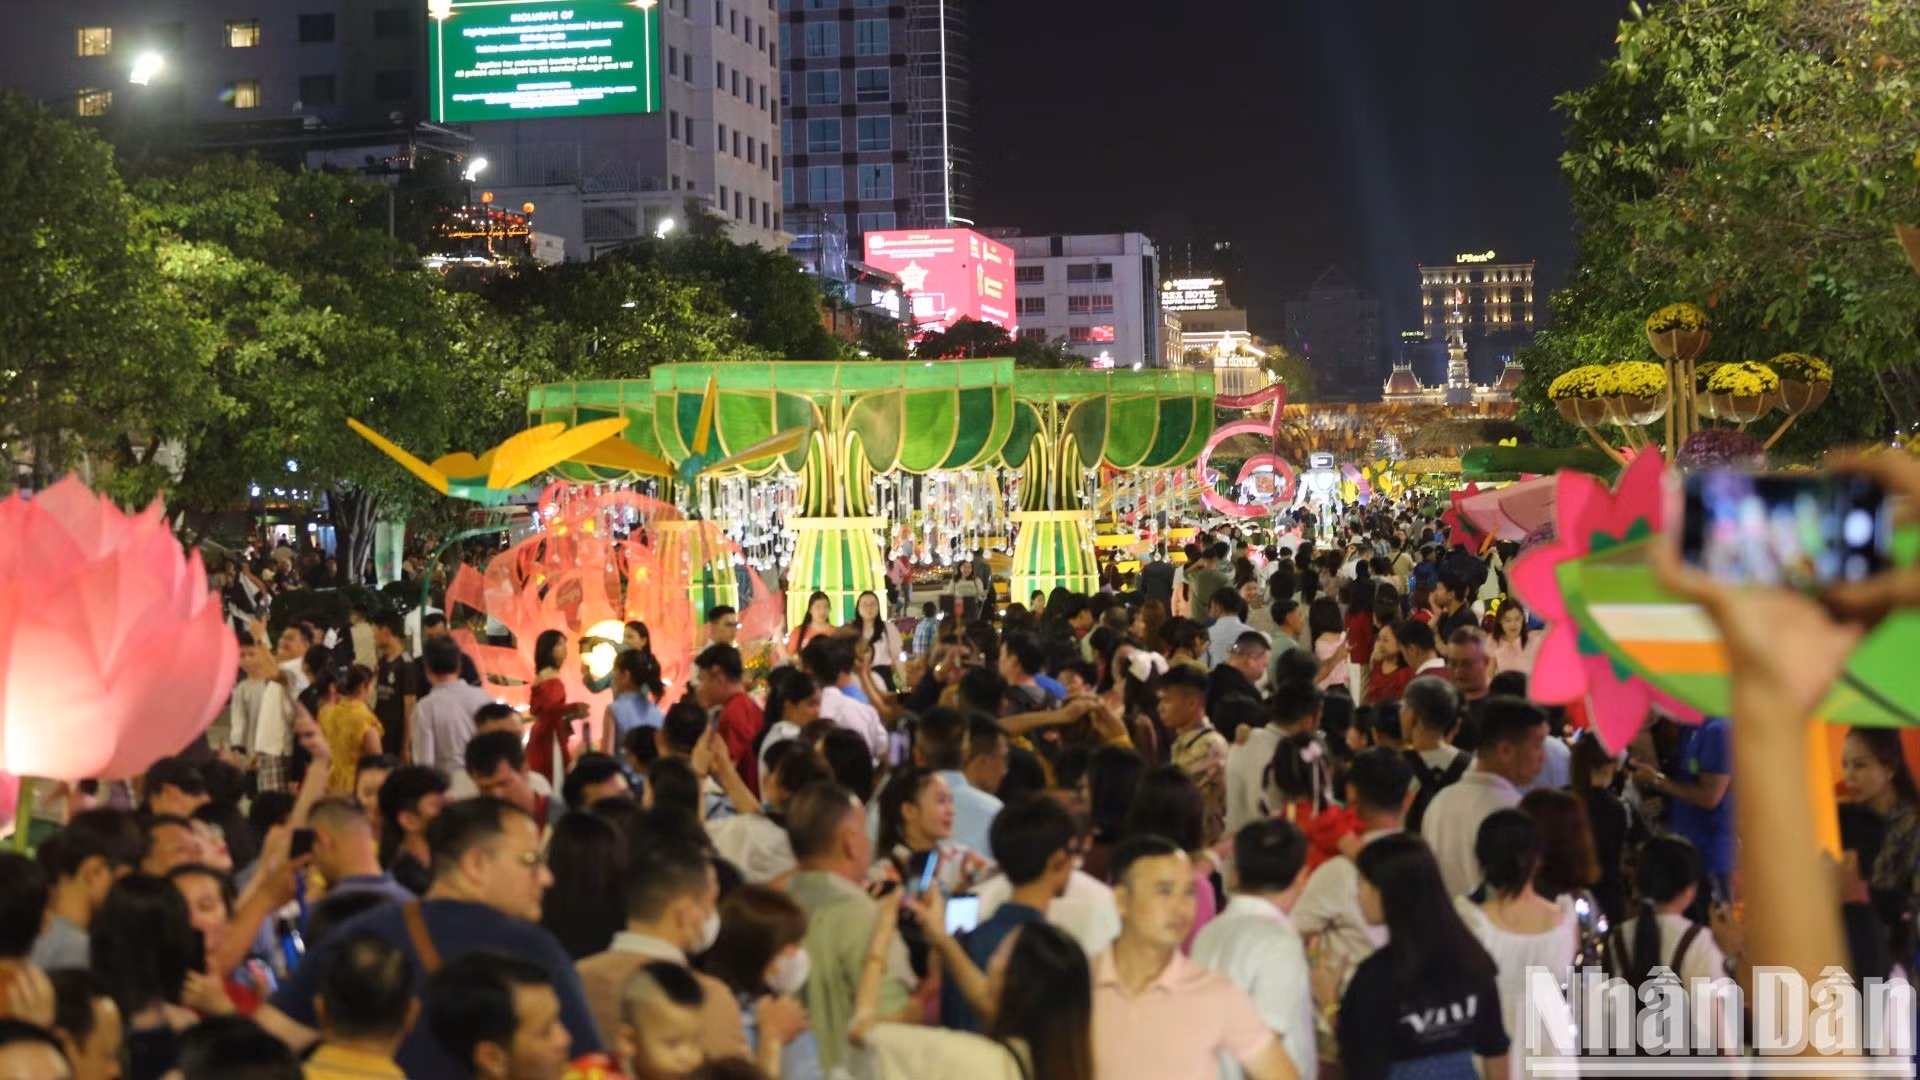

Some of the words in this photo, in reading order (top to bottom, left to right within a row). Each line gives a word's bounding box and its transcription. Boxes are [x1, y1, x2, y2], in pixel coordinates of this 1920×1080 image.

[511, 11, 558, 23] INCLUSIVE
[560, 10, 574, 20] OF
[1456, 253, 1487, 263] LPBank
[1161, 291, 1183, 300] REX
[1184, 289, 1218, 299] HOTEL
